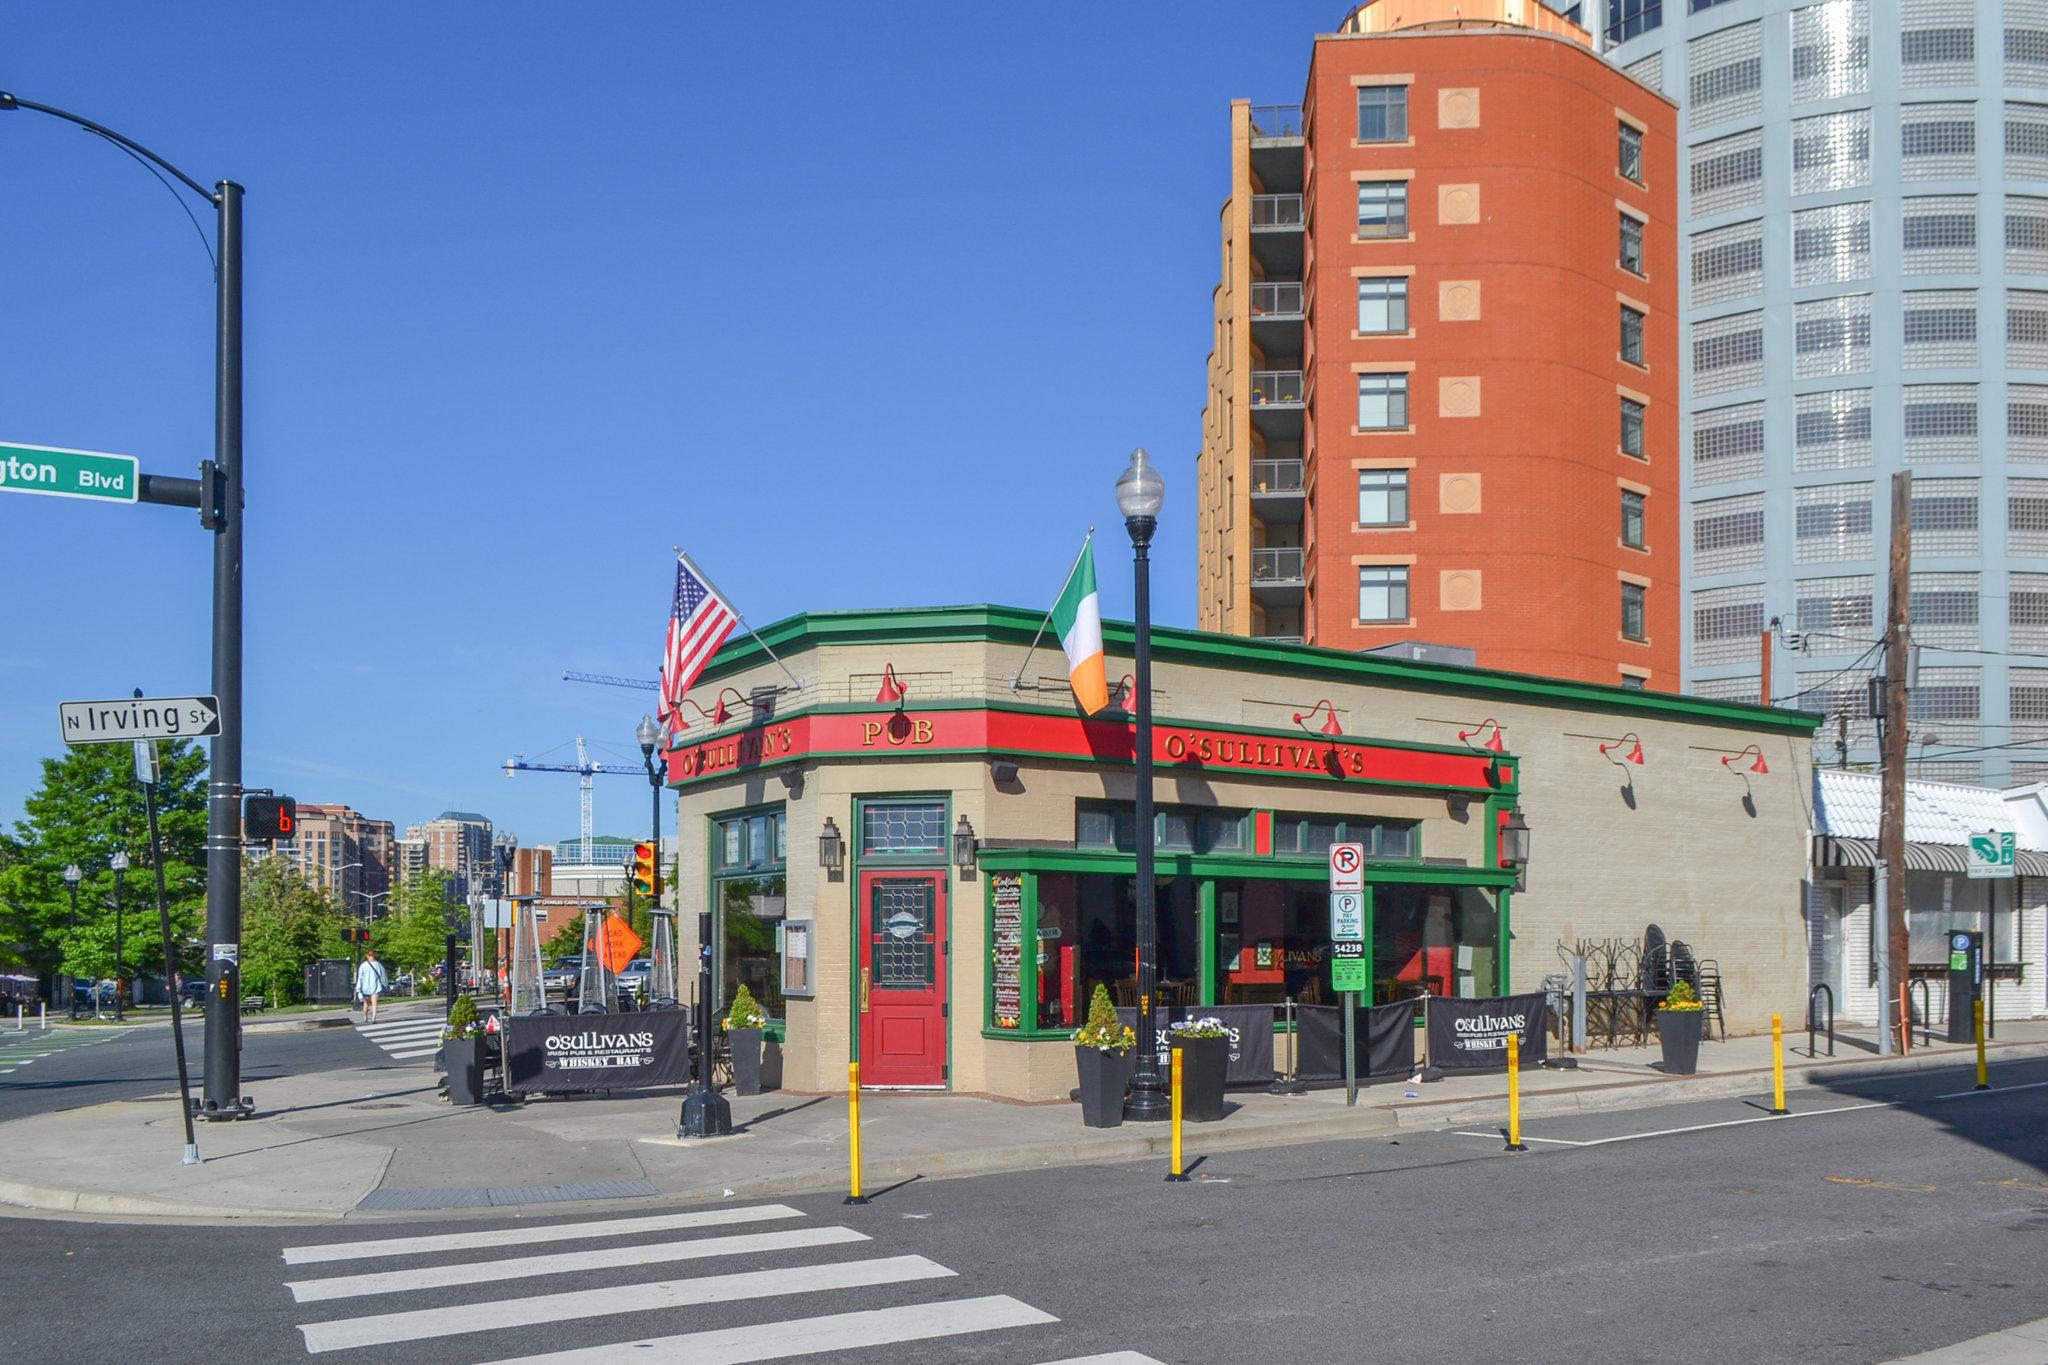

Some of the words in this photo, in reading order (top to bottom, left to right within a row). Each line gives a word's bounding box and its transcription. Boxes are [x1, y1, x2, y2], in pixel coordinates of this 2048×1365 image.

[79, 470, 124, 490] Blvd
[67, 715, 80, 729] N
[88, 703, 180, 733] Irving
[190, 709, 207, 723] St
[862, 719, 934, 745] PUB
[1165, 733, 1365, 774] O'SULLIVAN'S
[2002, 835, 2012, 846] 2
[1344, 898, 1351, 910] P
[1334, 943, 1363, 953] 54238
[603, 951, 627, 959] AEAD
[559, 1056, 609, 1067] WHISKEY
[616, 1055, 640, 1065] BAR
